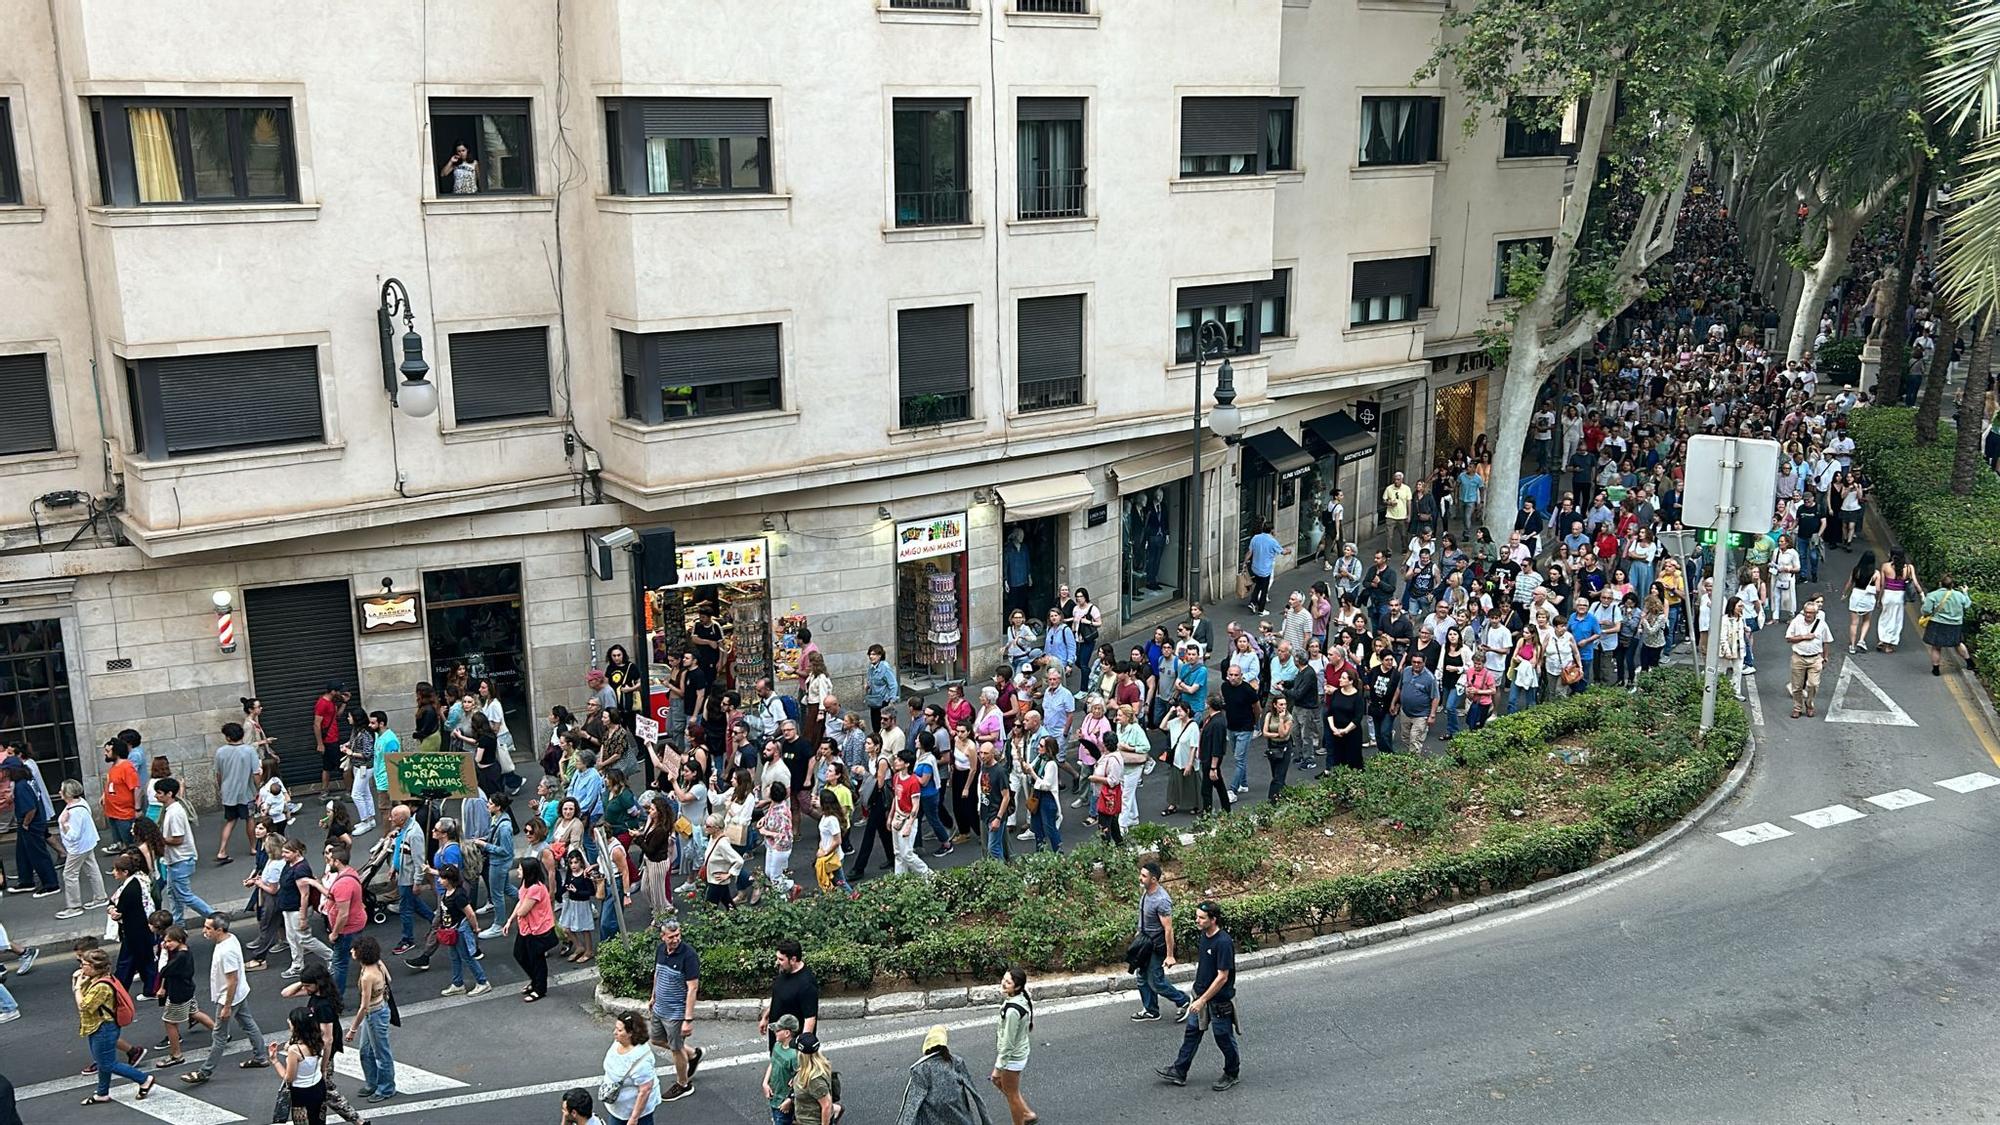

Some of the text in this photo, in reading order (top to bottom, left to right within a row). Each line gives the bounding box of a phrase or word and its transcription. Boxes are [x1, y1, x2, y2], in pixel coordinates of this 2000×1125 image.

[937, 539, 962, 551] MARKET
[684, 566, 761, 582] MINI MARKET
[404, 769, 439, 778] DAÑA
[414, 778, 424, 786] A
